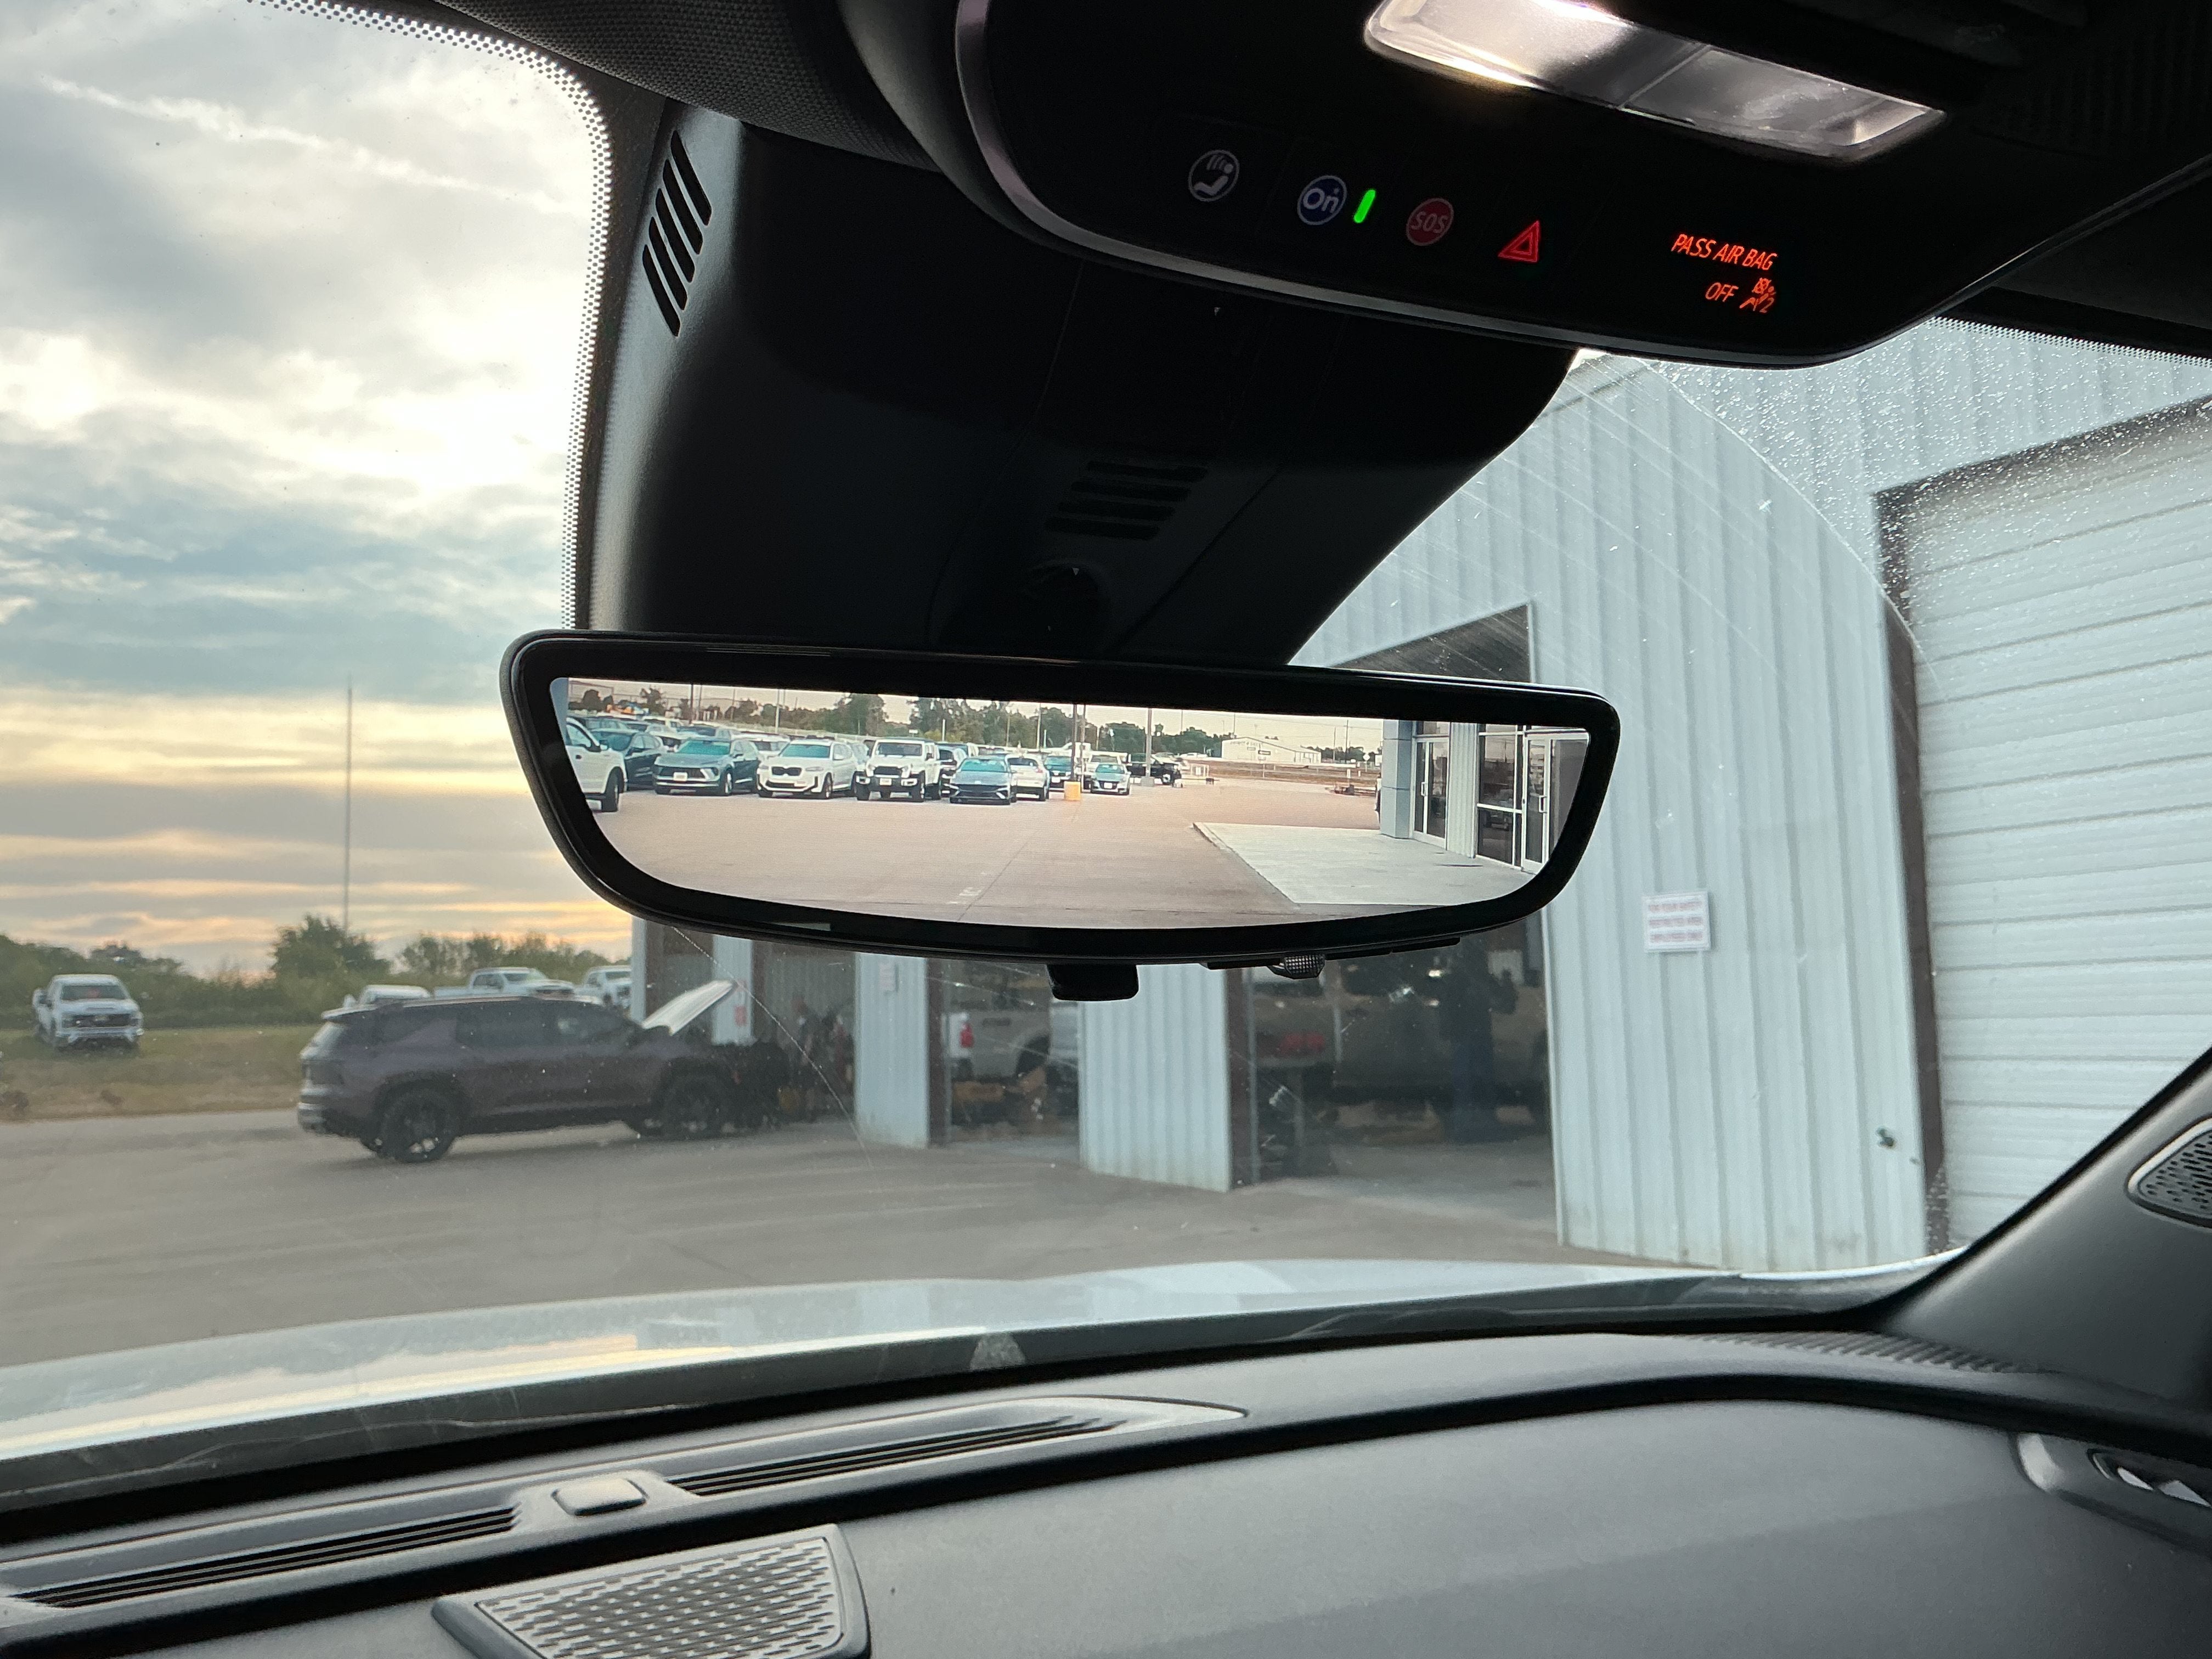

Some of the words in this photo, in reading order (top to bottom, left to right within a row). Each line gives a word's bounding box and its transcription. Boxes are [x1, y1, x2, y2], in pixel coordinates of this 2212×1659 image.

[1303, 188, 1339, 213] On
[1410, 211, 1448, 234] SOS
[1671, 233, 1717, 258] PASS
[1712, 244, 1745, 264] AIR
[1742, 249, 1778, 270] BAG
[1705, 282, 1739, 302] OFF
